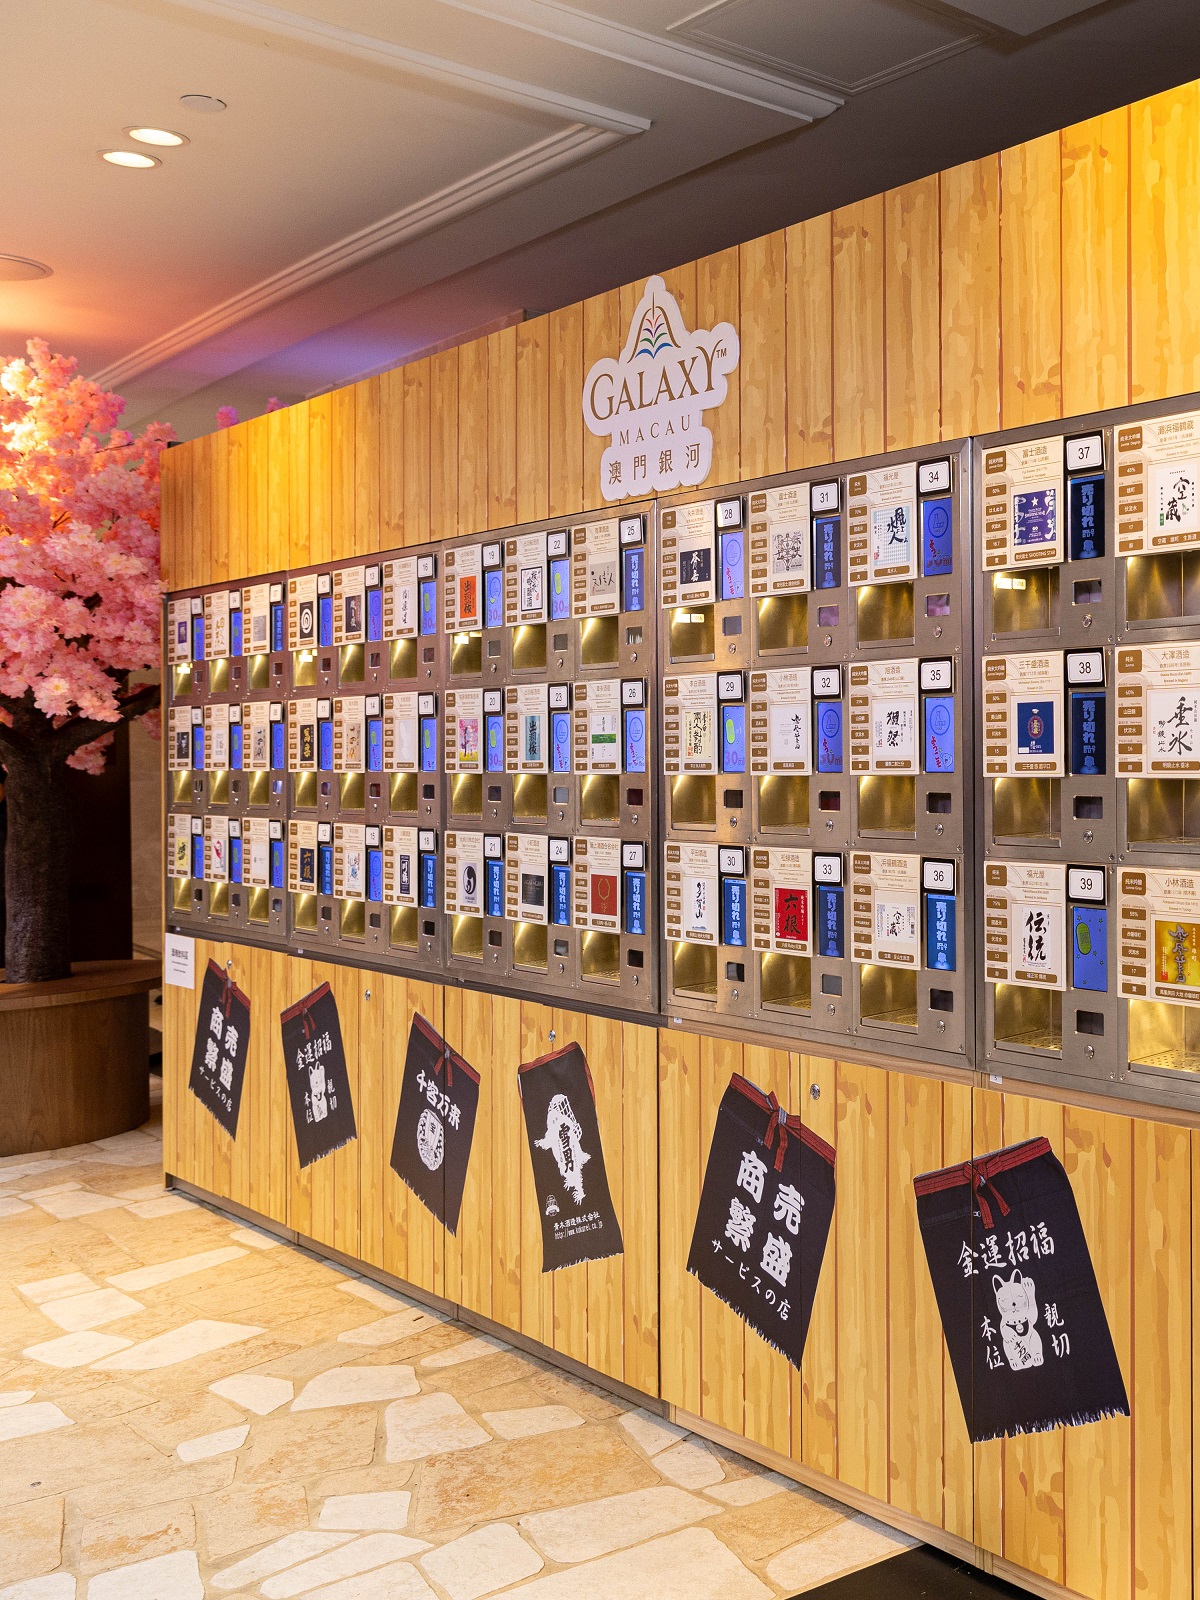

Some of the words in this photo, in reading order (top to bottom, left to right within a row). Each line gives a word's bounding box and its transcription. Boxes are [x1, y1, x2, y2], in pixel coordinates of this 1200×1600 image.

[590, 339, 723, 421] GALAXY
[619, 415, 691, 446] MACAU
[1078, 447, 1090, 459] 37
[608, 443, 701, 486] 澳門銀河
[929, 471, 940, 484] 34
[820, 492, 830, 504] 31
[1081, 484, 1094, 528] 売り切れ
[725, 509, 733, 520] 28
[626, 526, 635, 536] 25
[1079, 662, 1091, 674] 38
[930, 670, 942, 681] 35
[726, 682, 735, 693] 29
[822, 677, 831, 689] 32
[554, 693, 563, 702] 23
[627, 689, 637, 698] 26
[1083, 700, 1095, 743] 売り切れ
[555, 846, 563, 855] 24
[628, 852, 637, 861] 27
[727, 856, 736, 867] 30
[822, 864, 833, 875] 33
[933, 870, 945, 882] 36
[1080, 878, 1092, 890] 39
[1164, 877, 1194, 889] 小林酒造
[1025, 911, 1046, 961] 伝統
[957, 1221, 1056, 1278] 金運招福
[711, 1238, 791, 1321] サービスの店
[1044, 1302, 1070, 1358] 親切
[981, 1315, 1005, 1370] 本位
